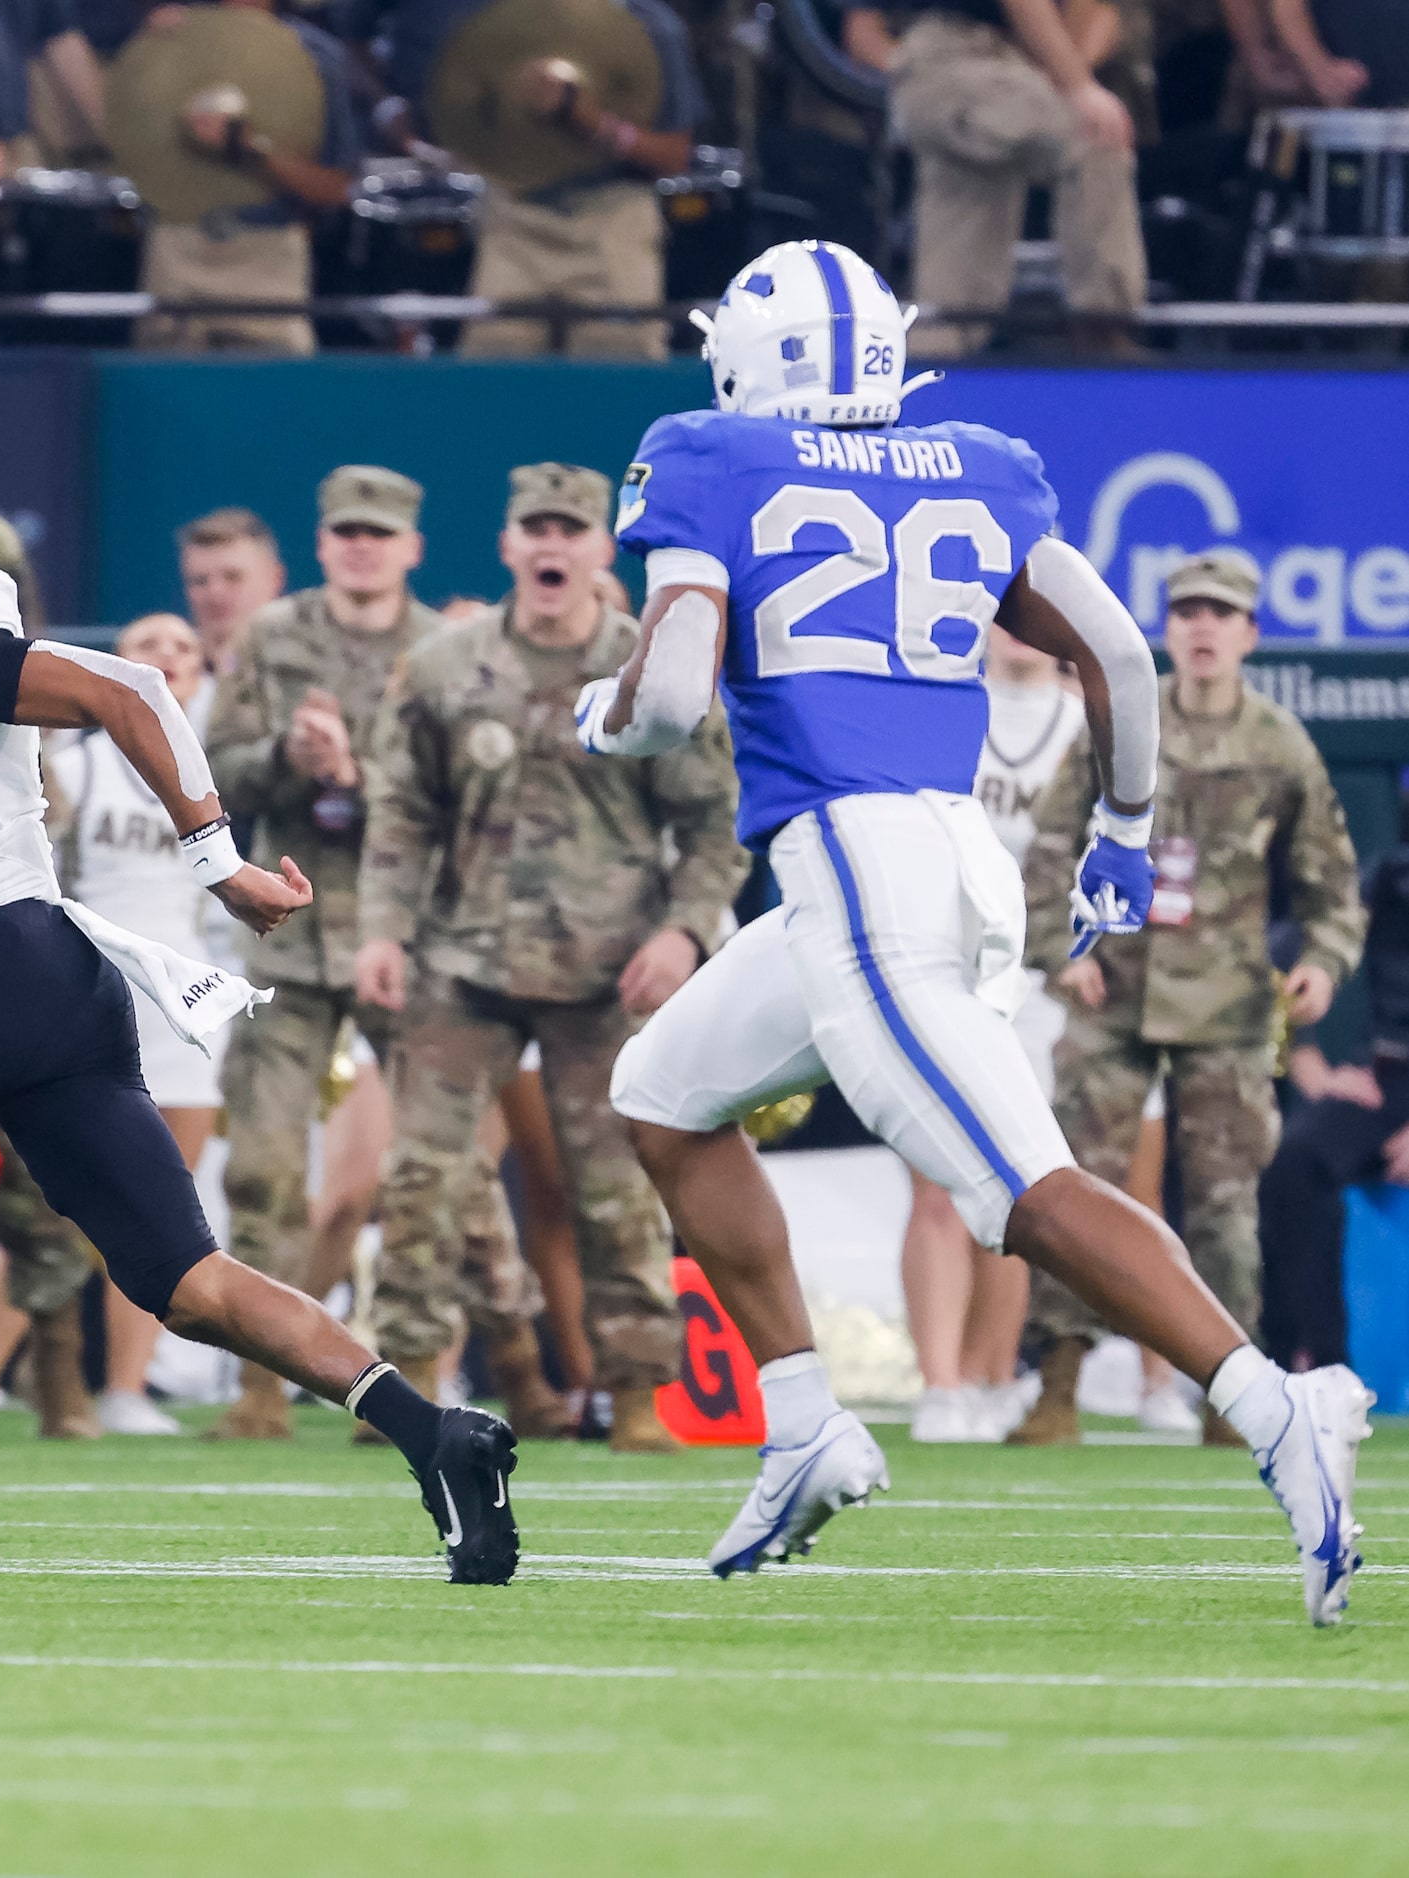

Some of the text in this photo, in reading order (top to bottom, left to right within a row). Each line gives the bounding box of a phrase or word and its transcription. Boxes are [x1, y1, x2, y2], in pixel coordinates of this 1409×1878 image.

[864, 344, 893, 376] 26
[830, 404, 893, 420] FORCE
[791, 430, 964, 480] SANFORD
[751, 483, 1012, 682] 26
[195, 822, 220, 842] DONE
[182, 972, 224, 1010] ARMY
[676, 1290, 741, 1420] G
